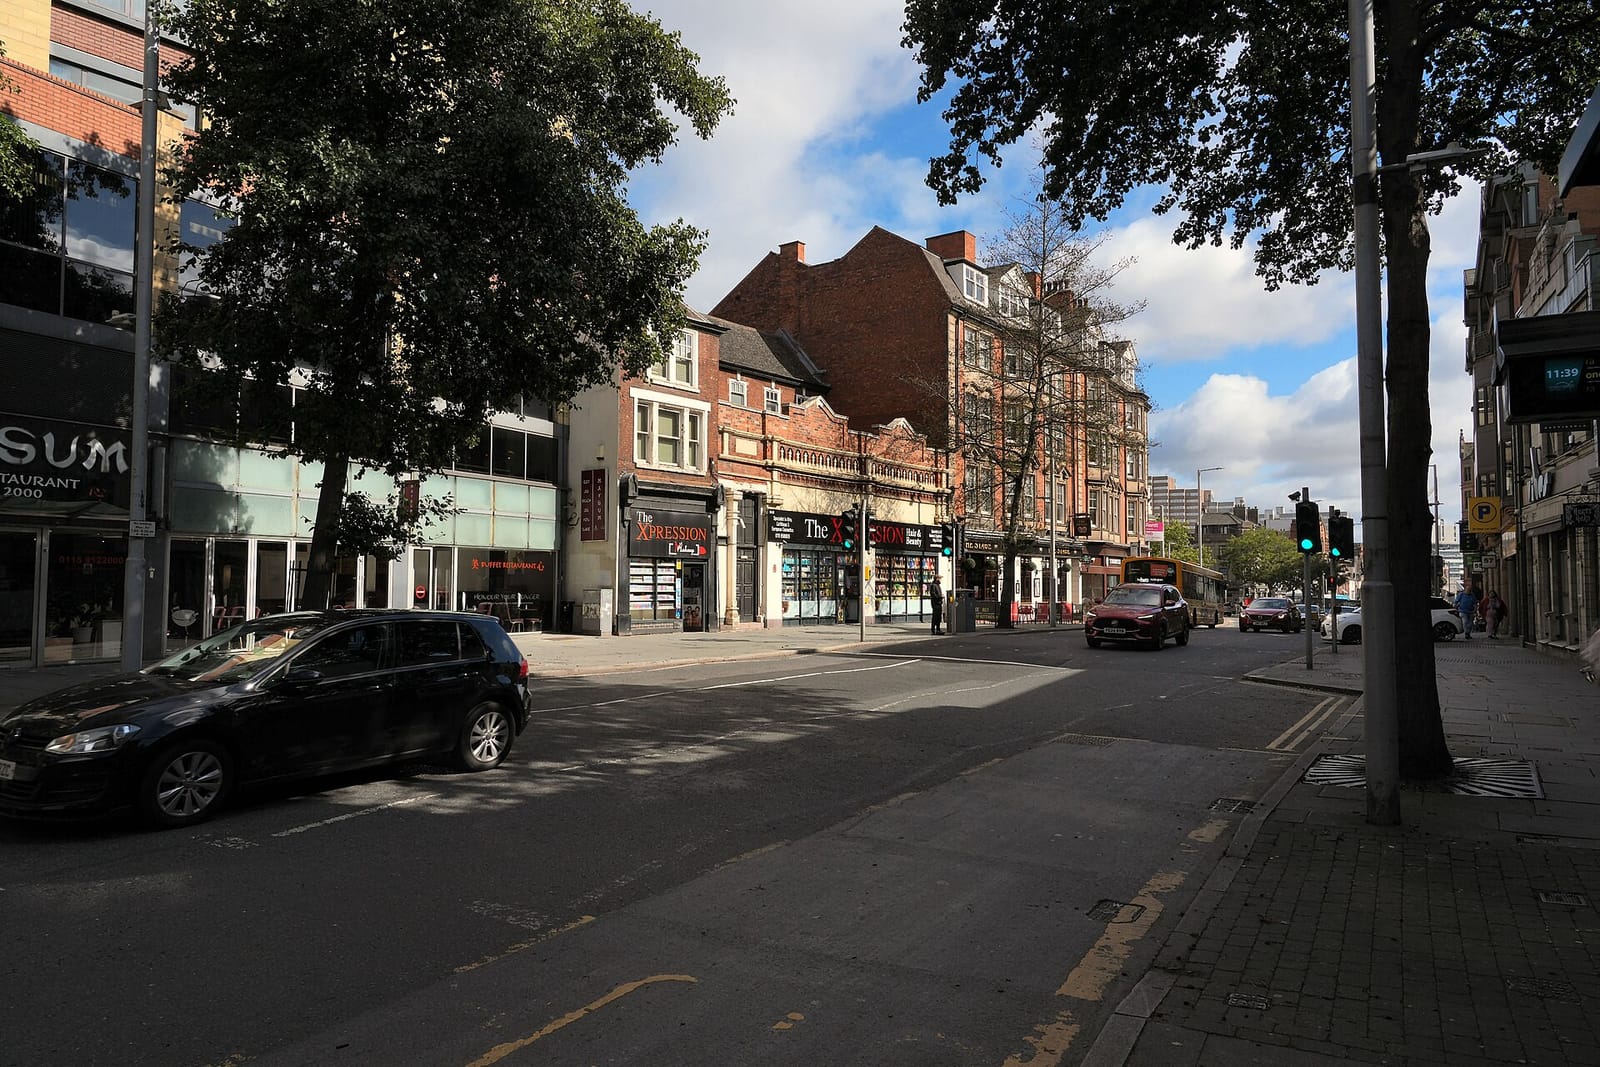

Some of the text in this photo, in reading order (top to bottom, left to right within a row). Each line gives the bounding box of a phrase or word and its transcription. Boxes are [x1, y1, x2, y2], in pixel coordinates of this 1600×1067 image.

[1546, 368, 1579, 379] 11:39
[4, 487, 43, 499] 2000
[636, 511, 653, 523] The
[1478, 505, 1491, 520] P
[636, 520, 707, 542] XPRESSION
[804, 518, 829, 539] The
